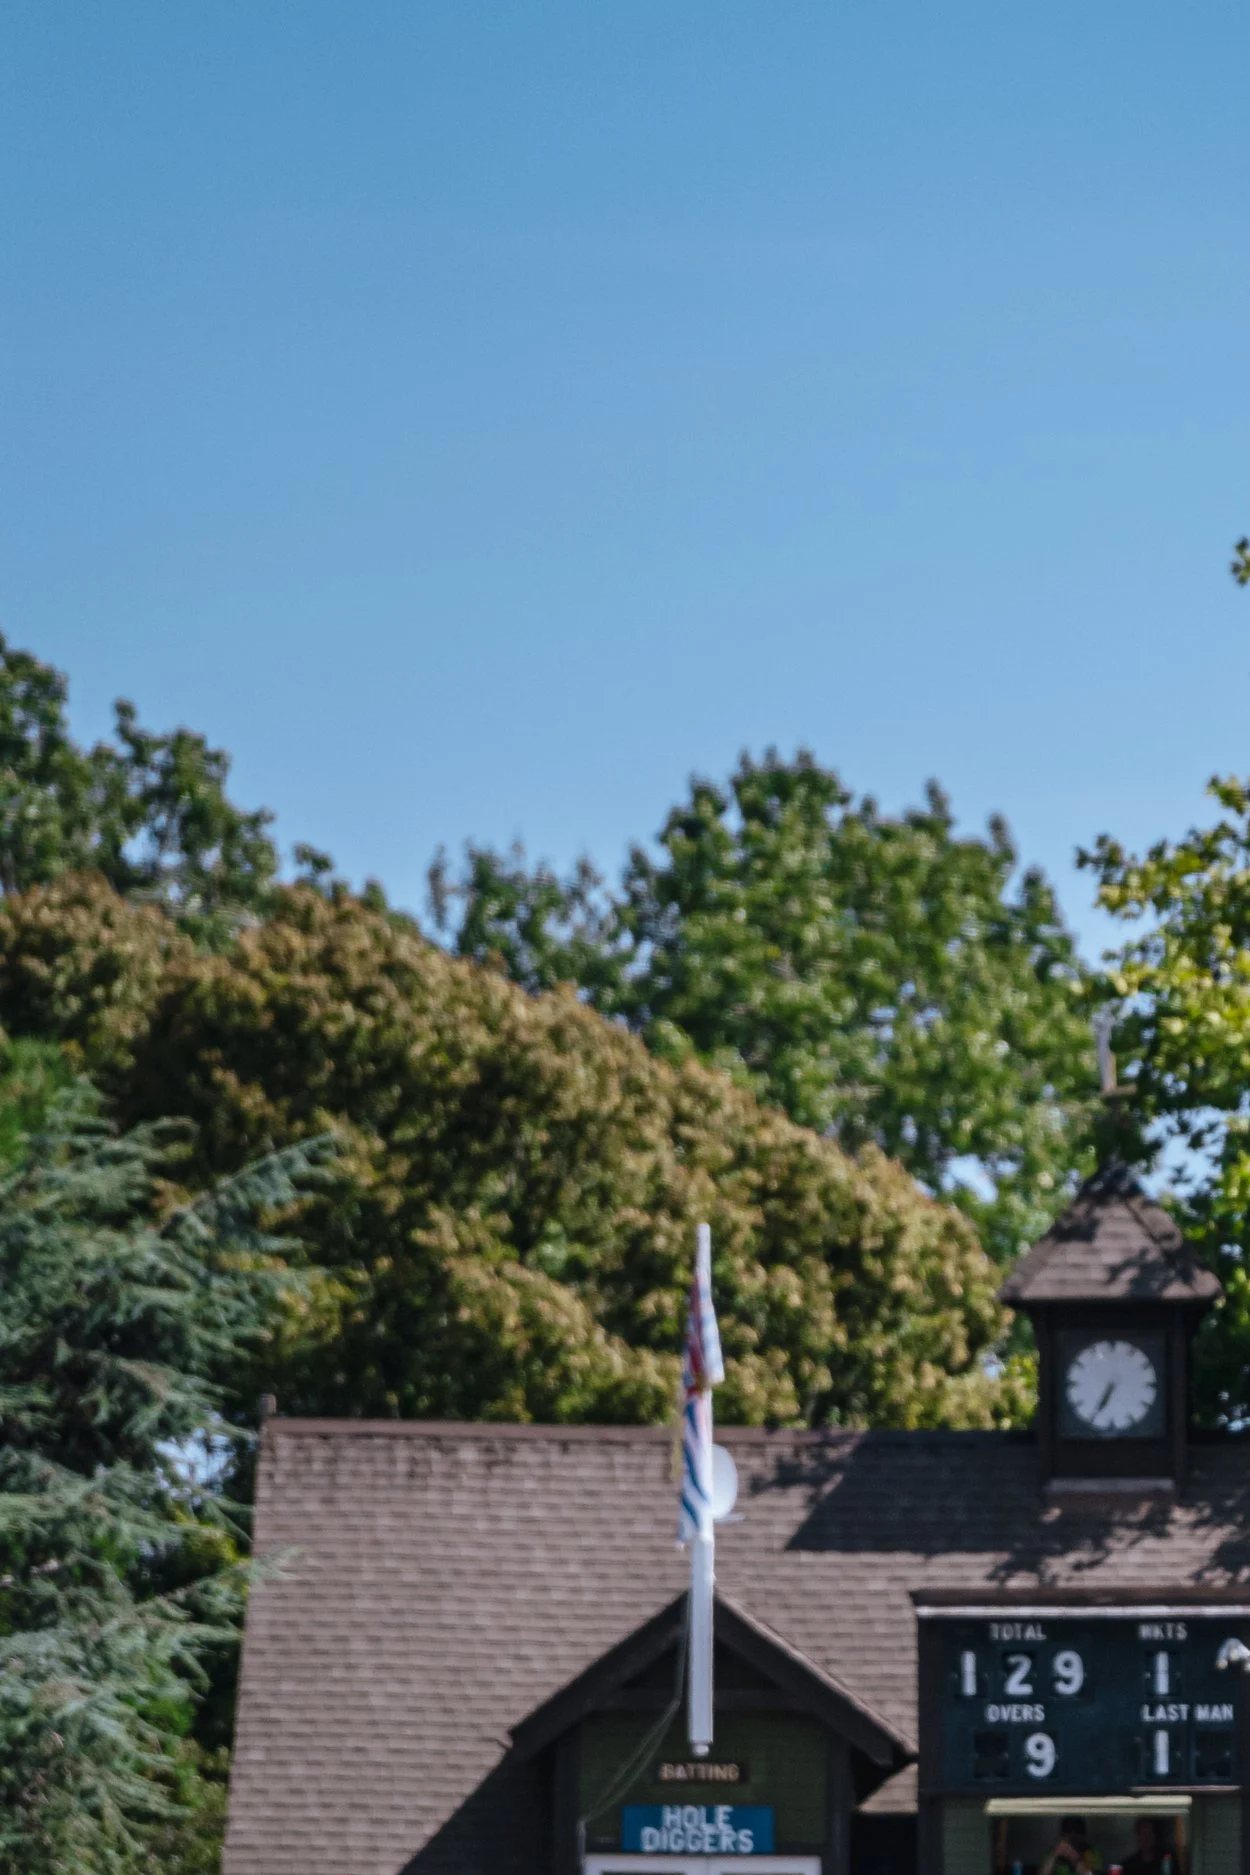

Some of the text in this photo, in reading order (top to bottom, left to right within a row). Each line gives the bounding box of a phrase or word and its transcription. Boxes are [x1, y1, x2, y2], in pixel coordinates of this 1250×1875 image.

[989, 1623, 1047, 1641] TOTAL
[1154, 1650, 1170, 1696] 1
[985, 1704, 1046, 1722] OVERS
[1142, 1704, 1234, 1722] LAST MAN
[1024, 1732, 1057, 1778] 9
[1154, 1730, 1170, 1776] 1
[659, 1763, 740, 1782] BATTING
[661, 1805, 734, 1831] HOLE
[640, 1826, 754, 1853] DIGGERS
